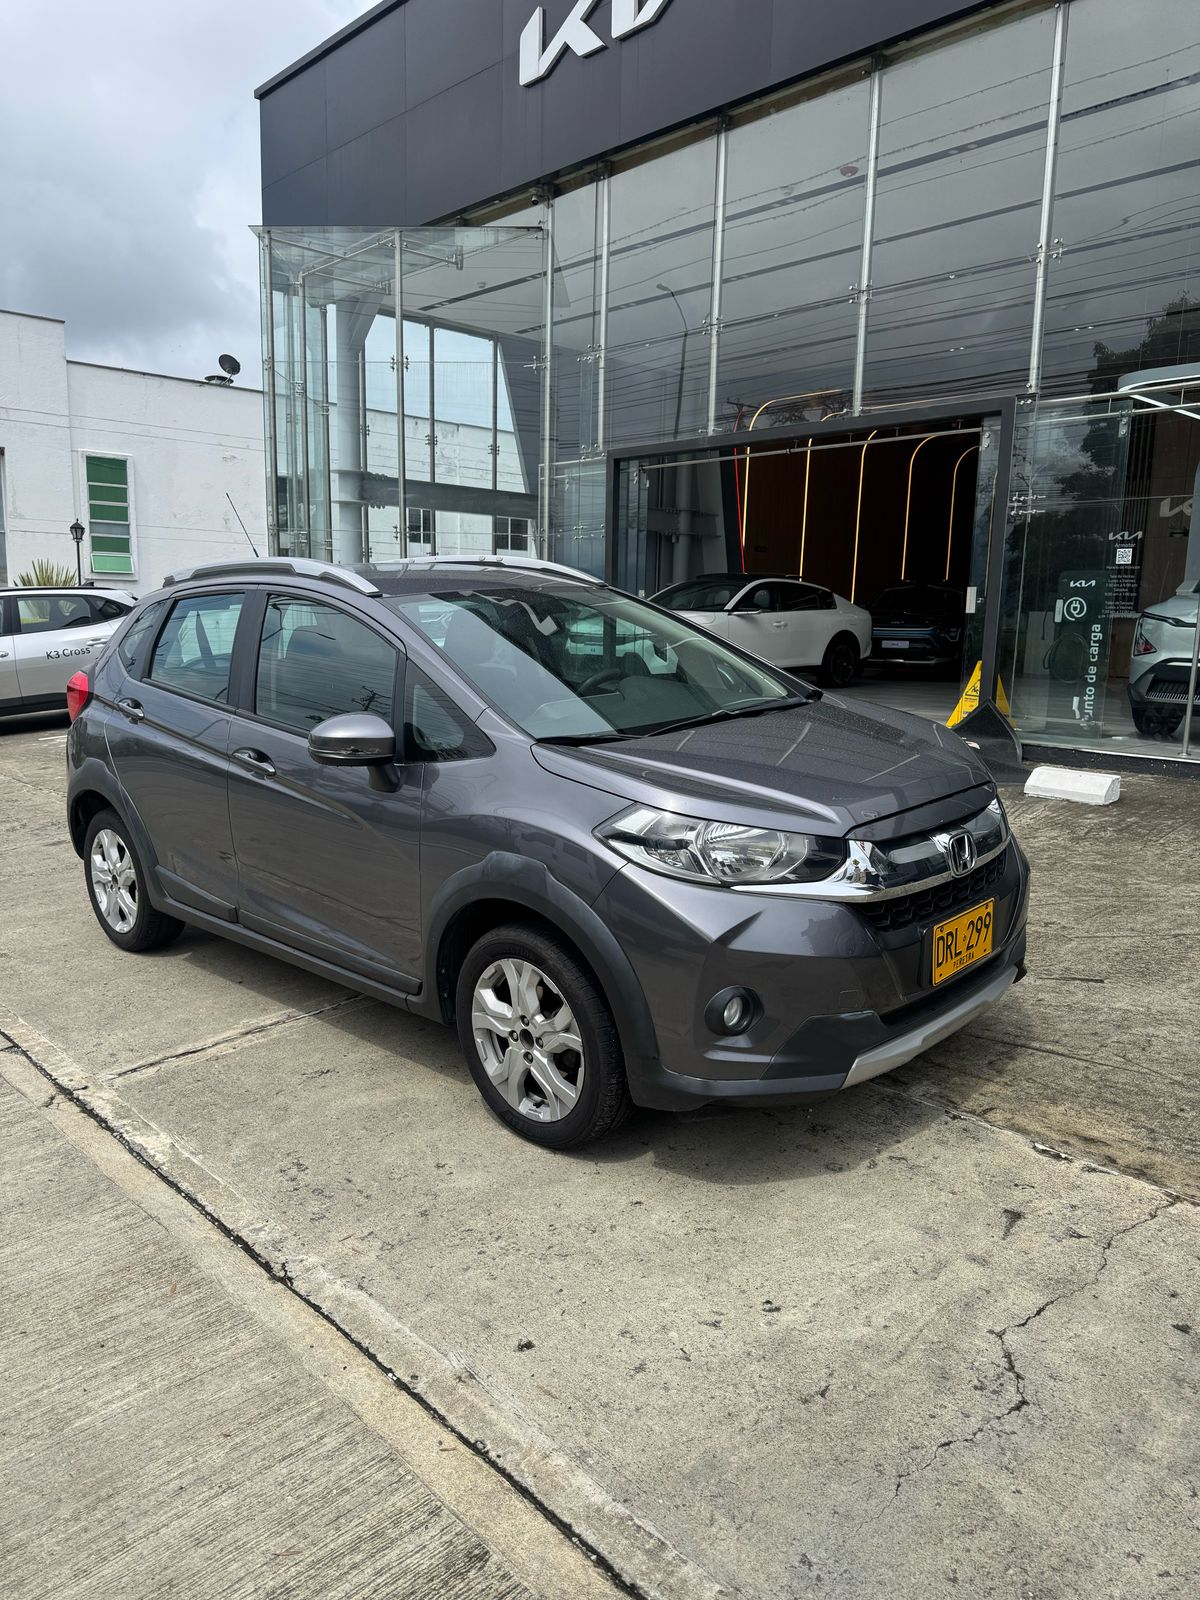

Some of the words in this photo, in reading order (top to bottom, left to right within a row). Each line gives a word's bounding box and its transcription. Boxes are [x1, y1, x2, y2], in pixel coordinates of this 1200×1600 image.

[46, 650, 60, 660] K3
[62, 646, 91, 658] Cross
[1089, 624, 1103, 662] carga
[1084, 665, 1097, 683] de
[1082, 686, 1095, 726] unto
[936, 927, 962, 968] DRL
[966, 911, 992, 952] 299
[953, 950, 975, 969] PEREIRA
